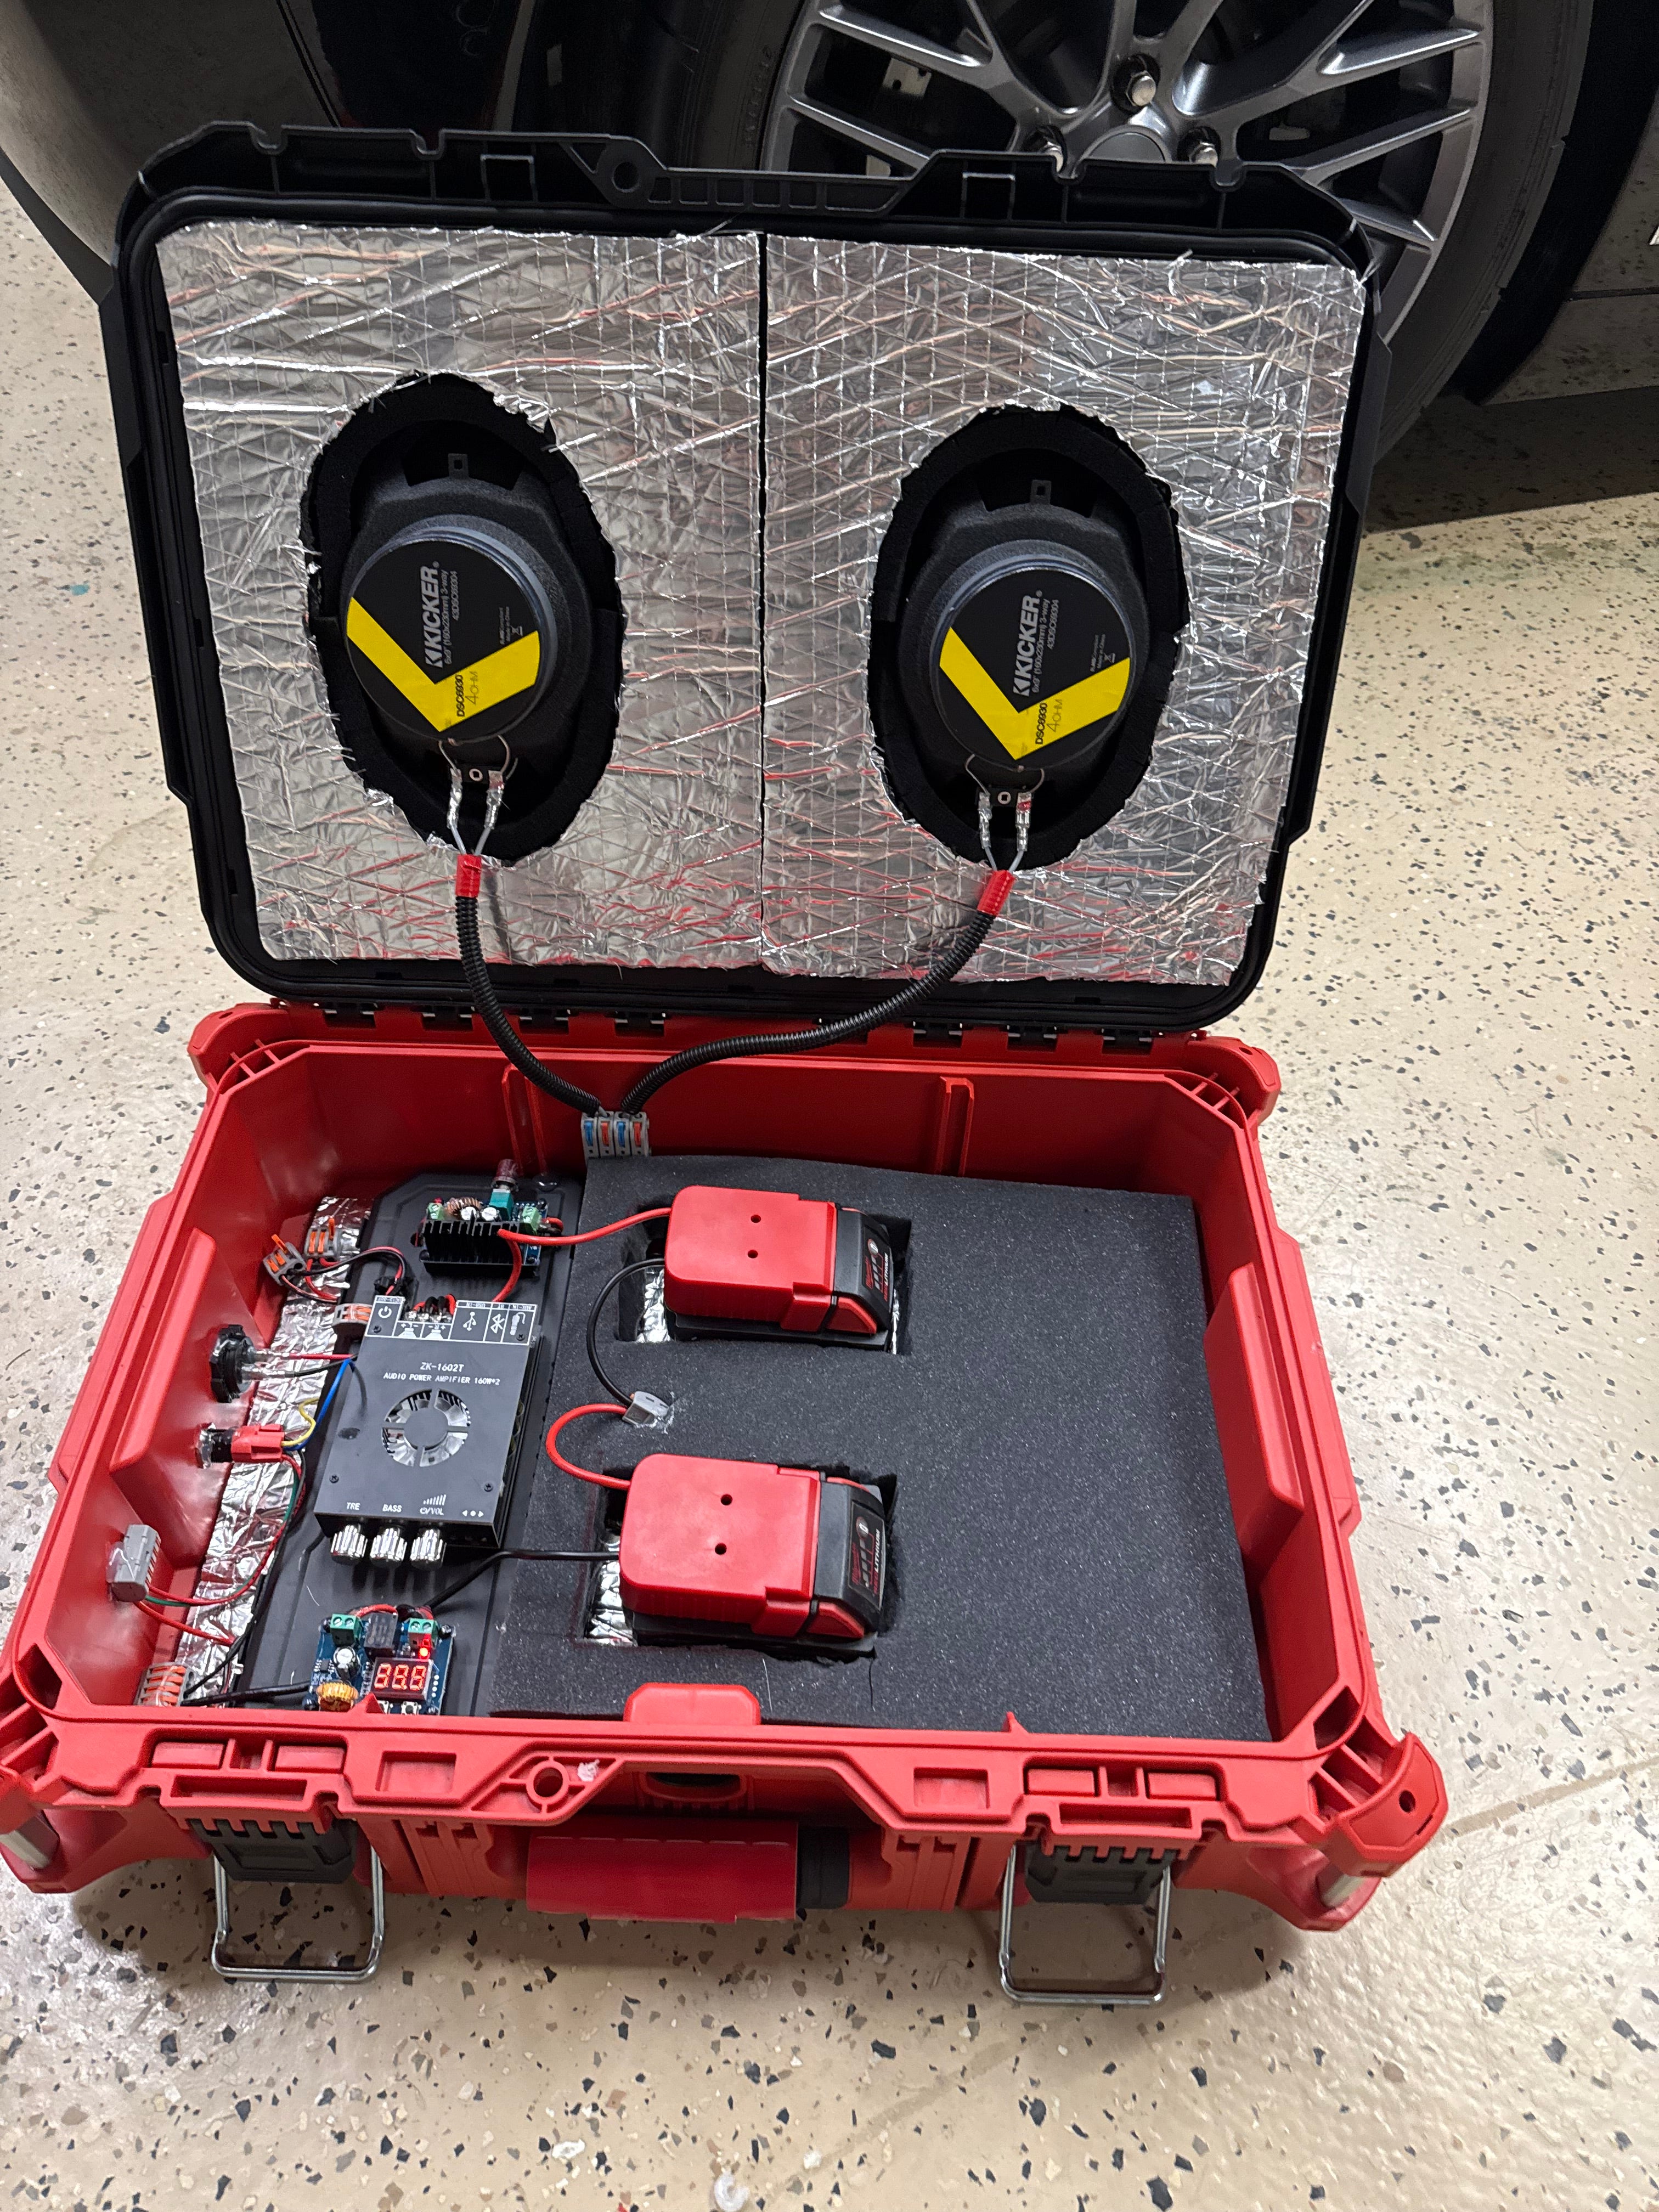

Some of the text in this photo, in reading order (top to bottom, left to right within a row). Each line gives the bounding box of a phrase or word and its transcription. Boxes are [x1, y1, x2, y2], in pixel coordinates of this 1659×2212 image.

[420, 566, 443, 651] KICKER
[1014, 595, 1040, 679] KICKER
[420, 1362, 465, 1373] ZK-1602T
[383, 1372, 407, 1380] AUDIO
[409, 1373, 432, 1381] POWER
[435, 1375, 470, 1384] AMPIFIER
[346, 1502, 360, 1511] TRE
[382, 1504, 402, 1513] BASS
